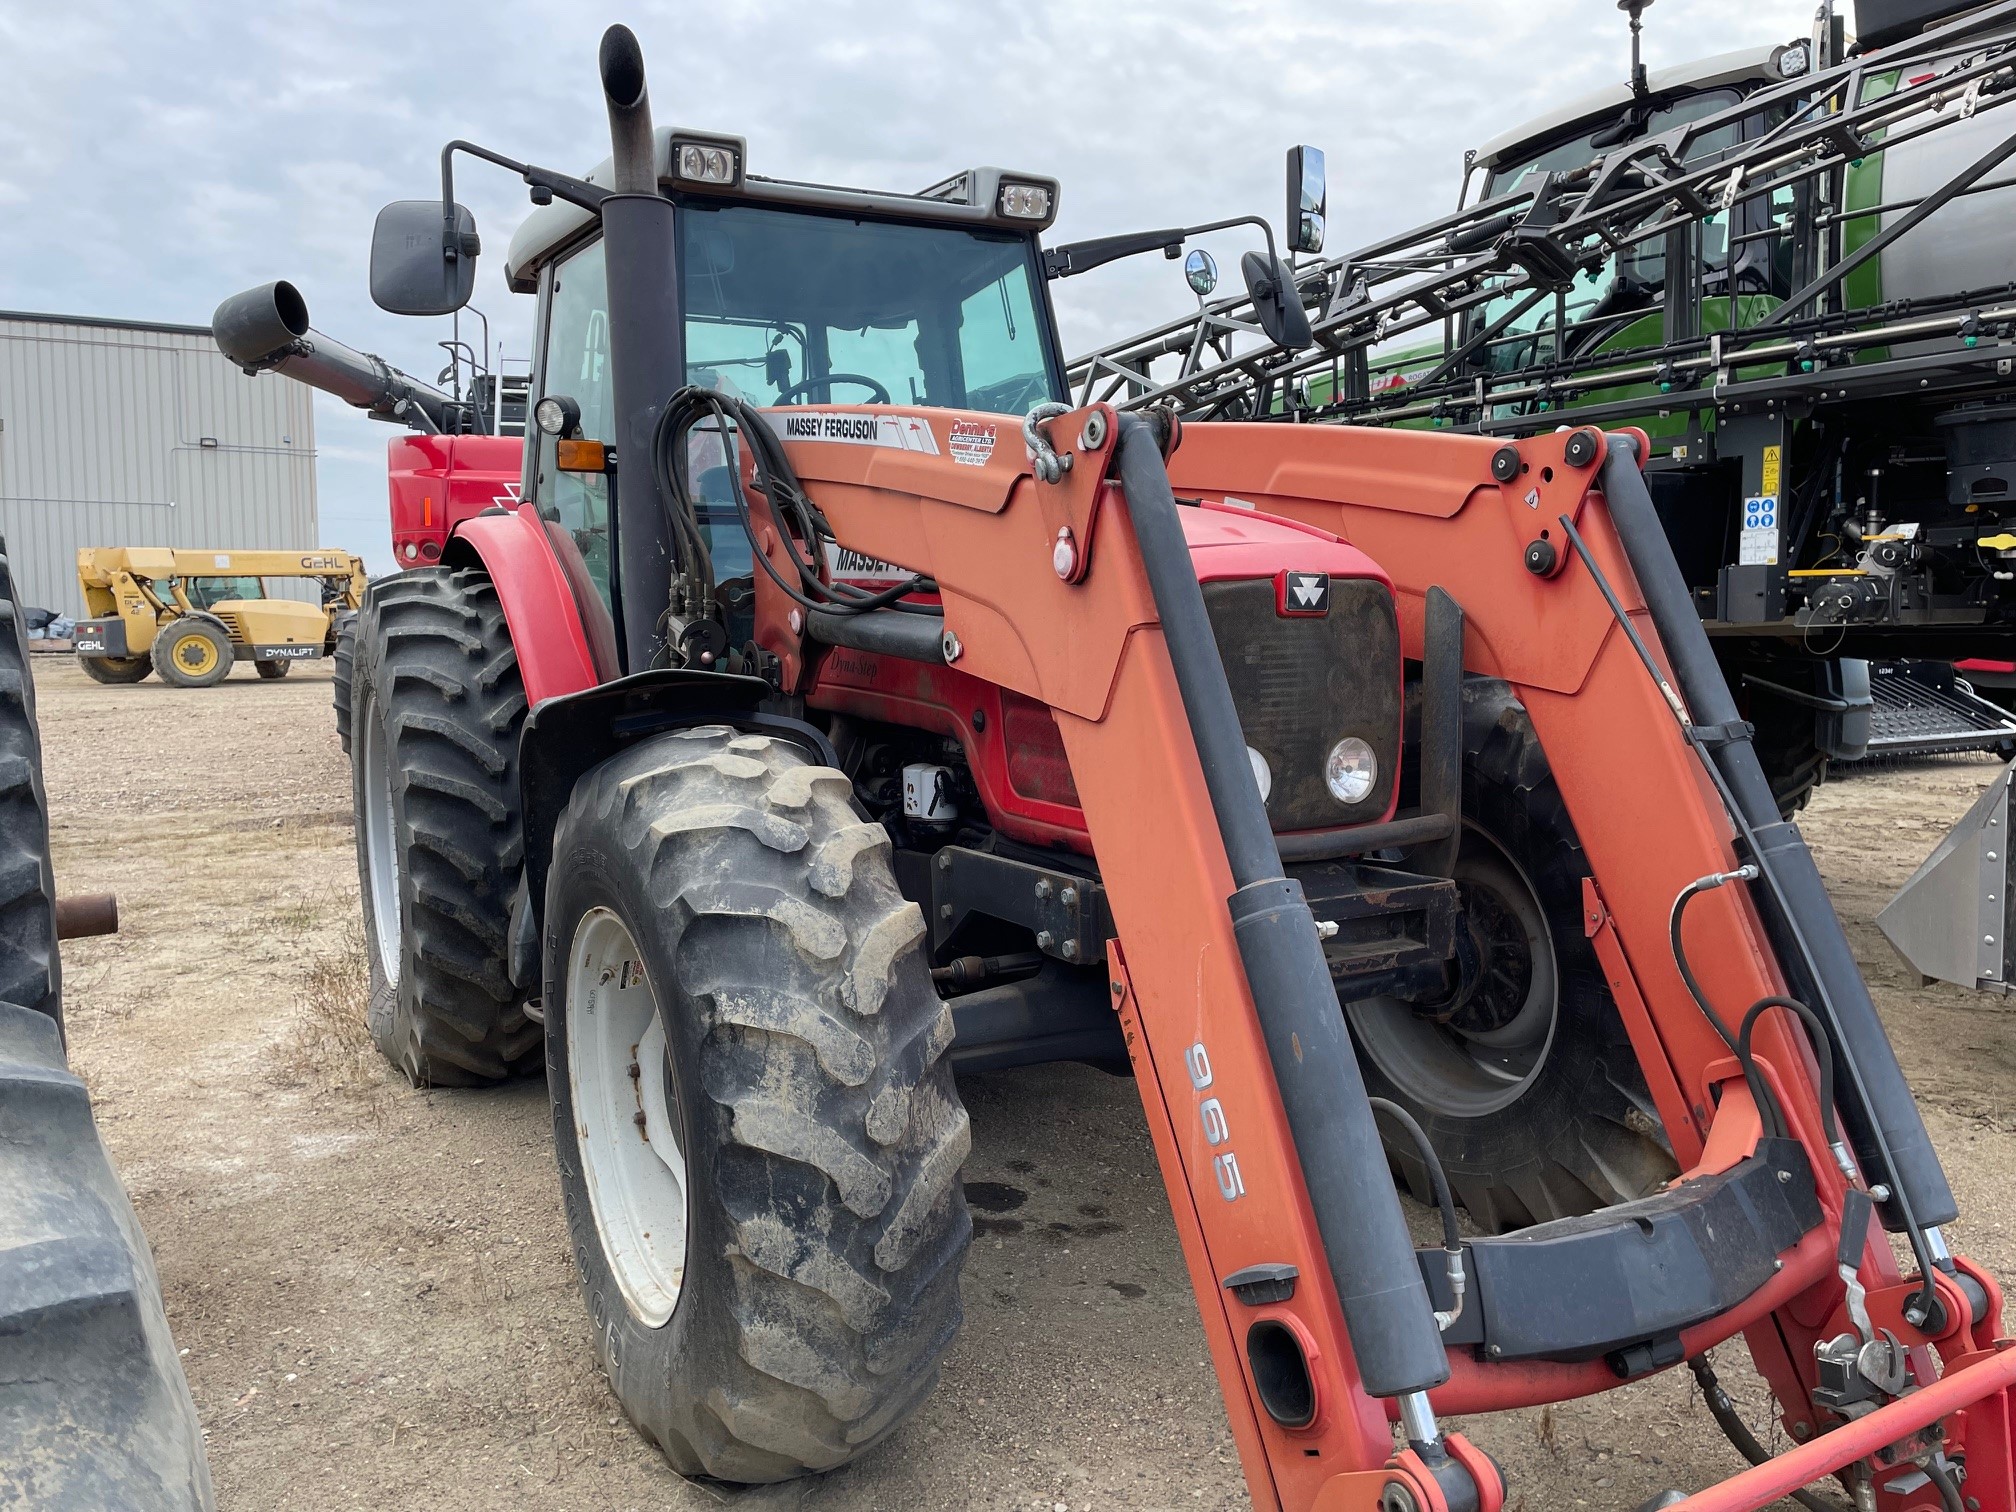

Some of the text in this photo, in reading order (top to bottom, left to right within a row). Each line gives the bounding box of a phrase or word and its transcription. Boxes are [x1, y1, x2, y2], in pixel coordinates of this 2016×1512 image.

[786, 418, 878, 440] MASSEY FERGUSON
[301, 557, 344, 569] GEHL
[78, 640, 105, 651] GEHL
[265, 648, 314, 657] DYNALIFT
[830, 651, 877, 684] Dyna-Step
[1184, 1042, 1247, 1203] 965
